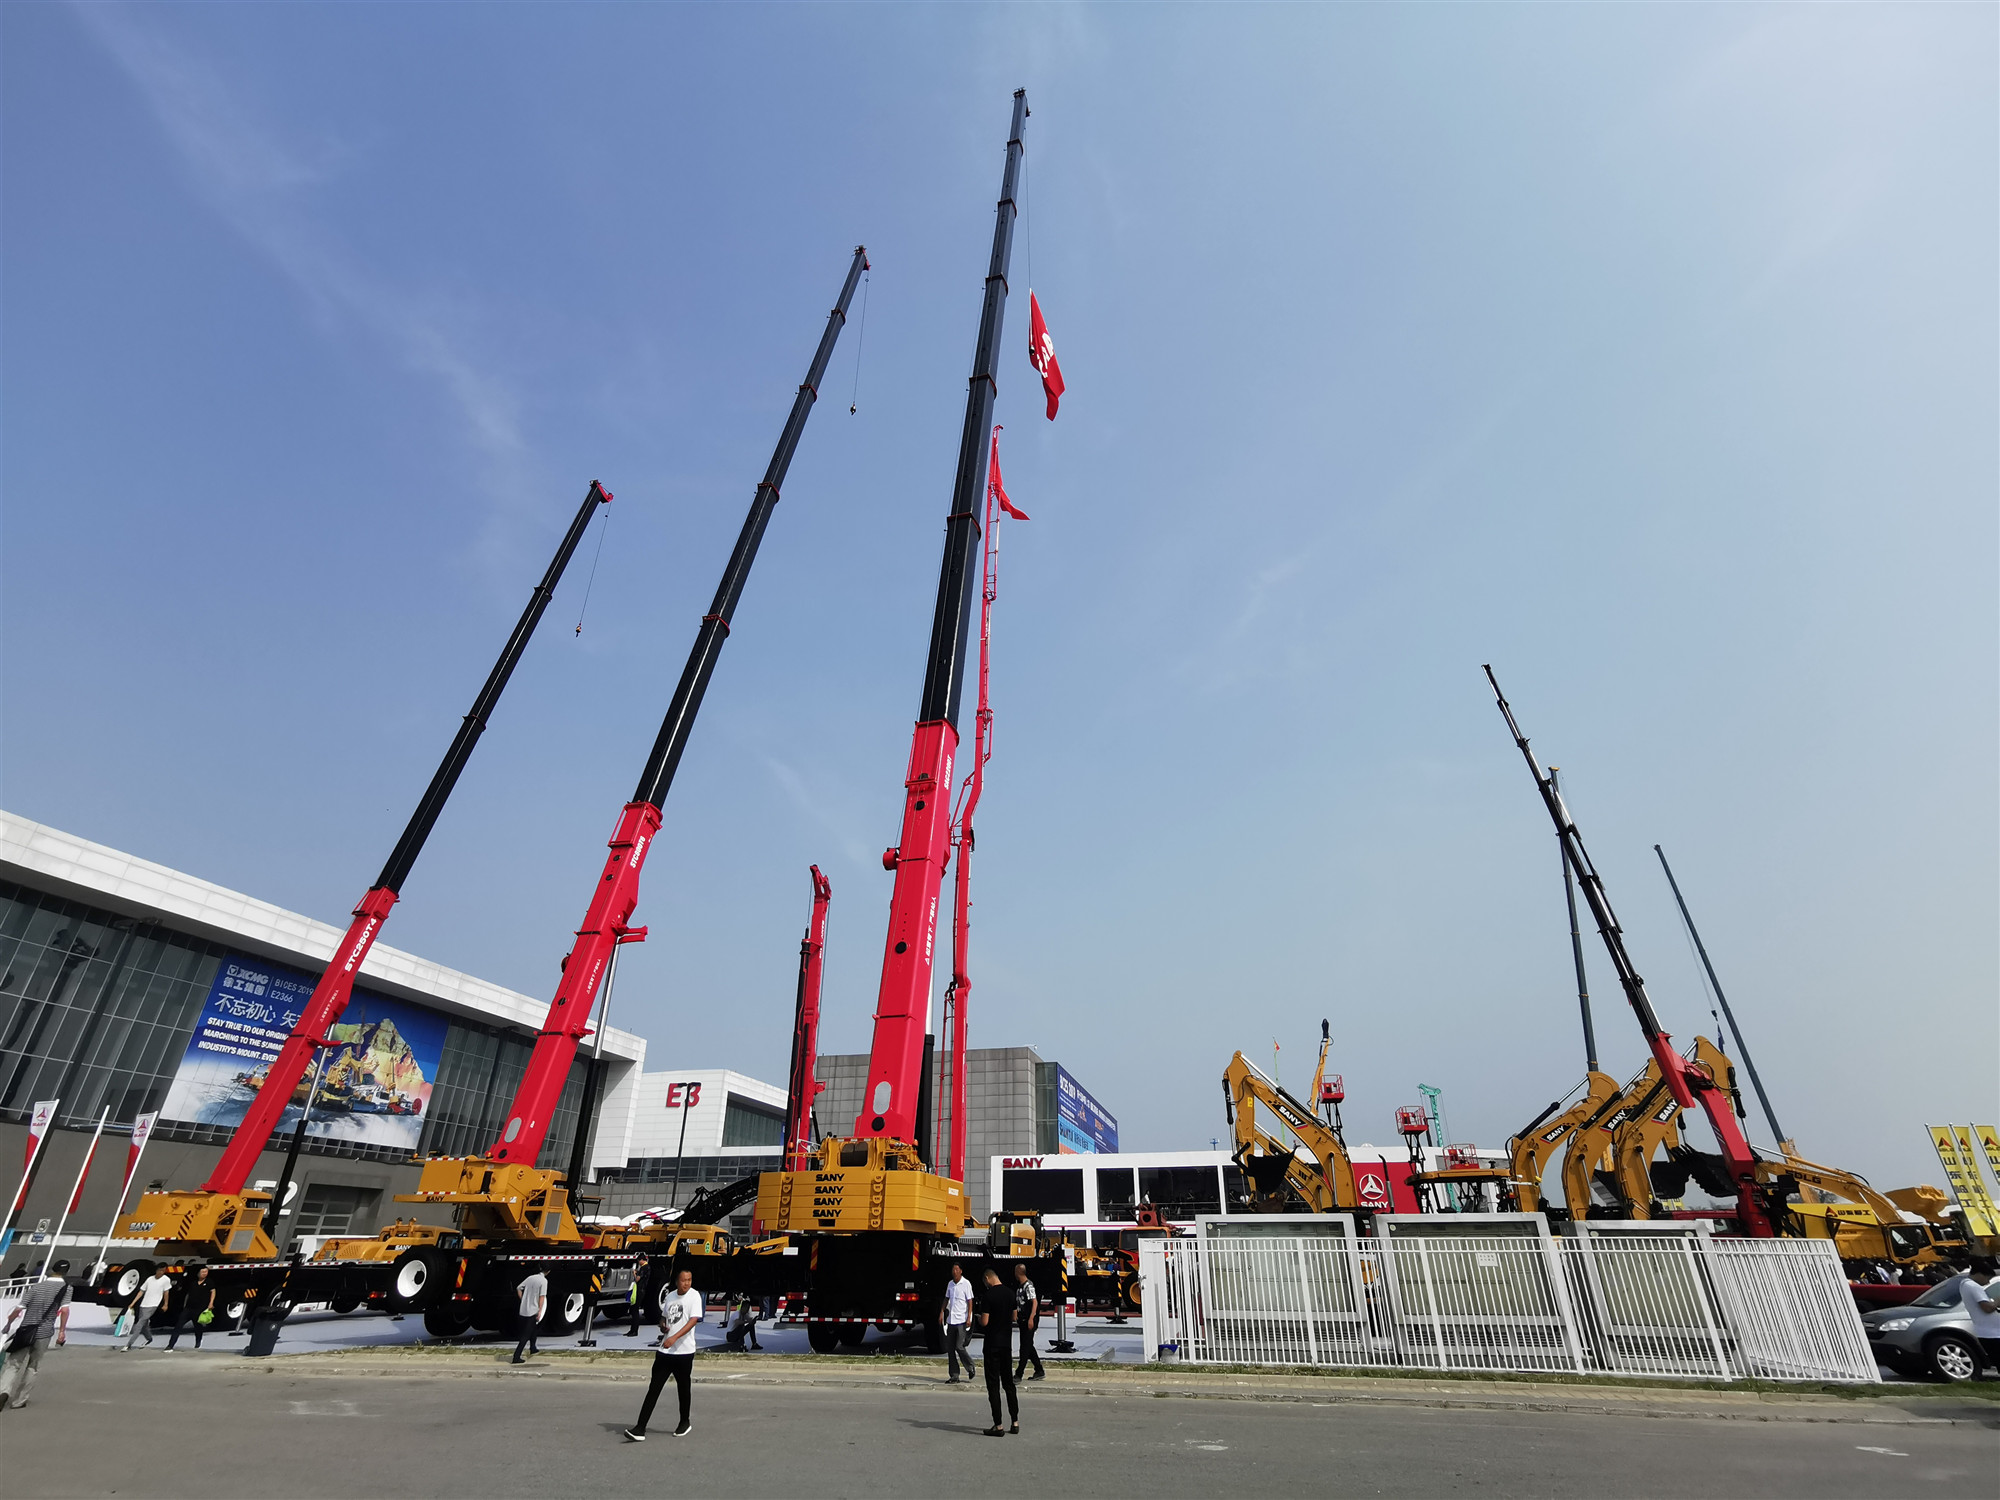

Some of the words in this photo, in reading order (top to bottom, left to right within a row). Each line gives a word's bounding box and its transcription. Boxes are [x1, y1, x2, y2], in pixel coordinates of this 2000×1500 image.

[344, 918, 377, 972] STC250T4
[237, 969, 269, 984] XCMG
[275, 979, 296, 992] BICES
[298, 986, 314, 996] 2019
[271, 990, 293, 1003] E2366
[215, 993, 276, 1023] 不忘初心
[280, 1010, 301, 1028] 矢
[208, 1017, 225, 1027] STAY
[225, 1020, 241, 1031] TRUE
[243, 1024, 251, 1032] TO
[252, 1027, 265, 1036] OUR
[203, 1029, 240, 1043] MARCHING
[240, 1036, 249, 1044] TO
[250, 1038, 261, 1047] THE
[198, 1041, 237, 1054] INDUSTRY'S
[666, 1083, 701, 1107] E3
[1278, 1106, 1302, 1126] SANY
[1660, 1100, 1679, 1120] SANY
[1608, 1110, 1626, 1130] SANY
[1547, 1125, 1565, 1141] SANY
[1002, 1158, 1044, 1168] SANY
[815, 1186, 844, 1194] SANY
[1290, 1177, 1302, 1189] SANY
[814, 1198, 843, 1206] SANY
[129, 1222, 156, 1232] SANY
